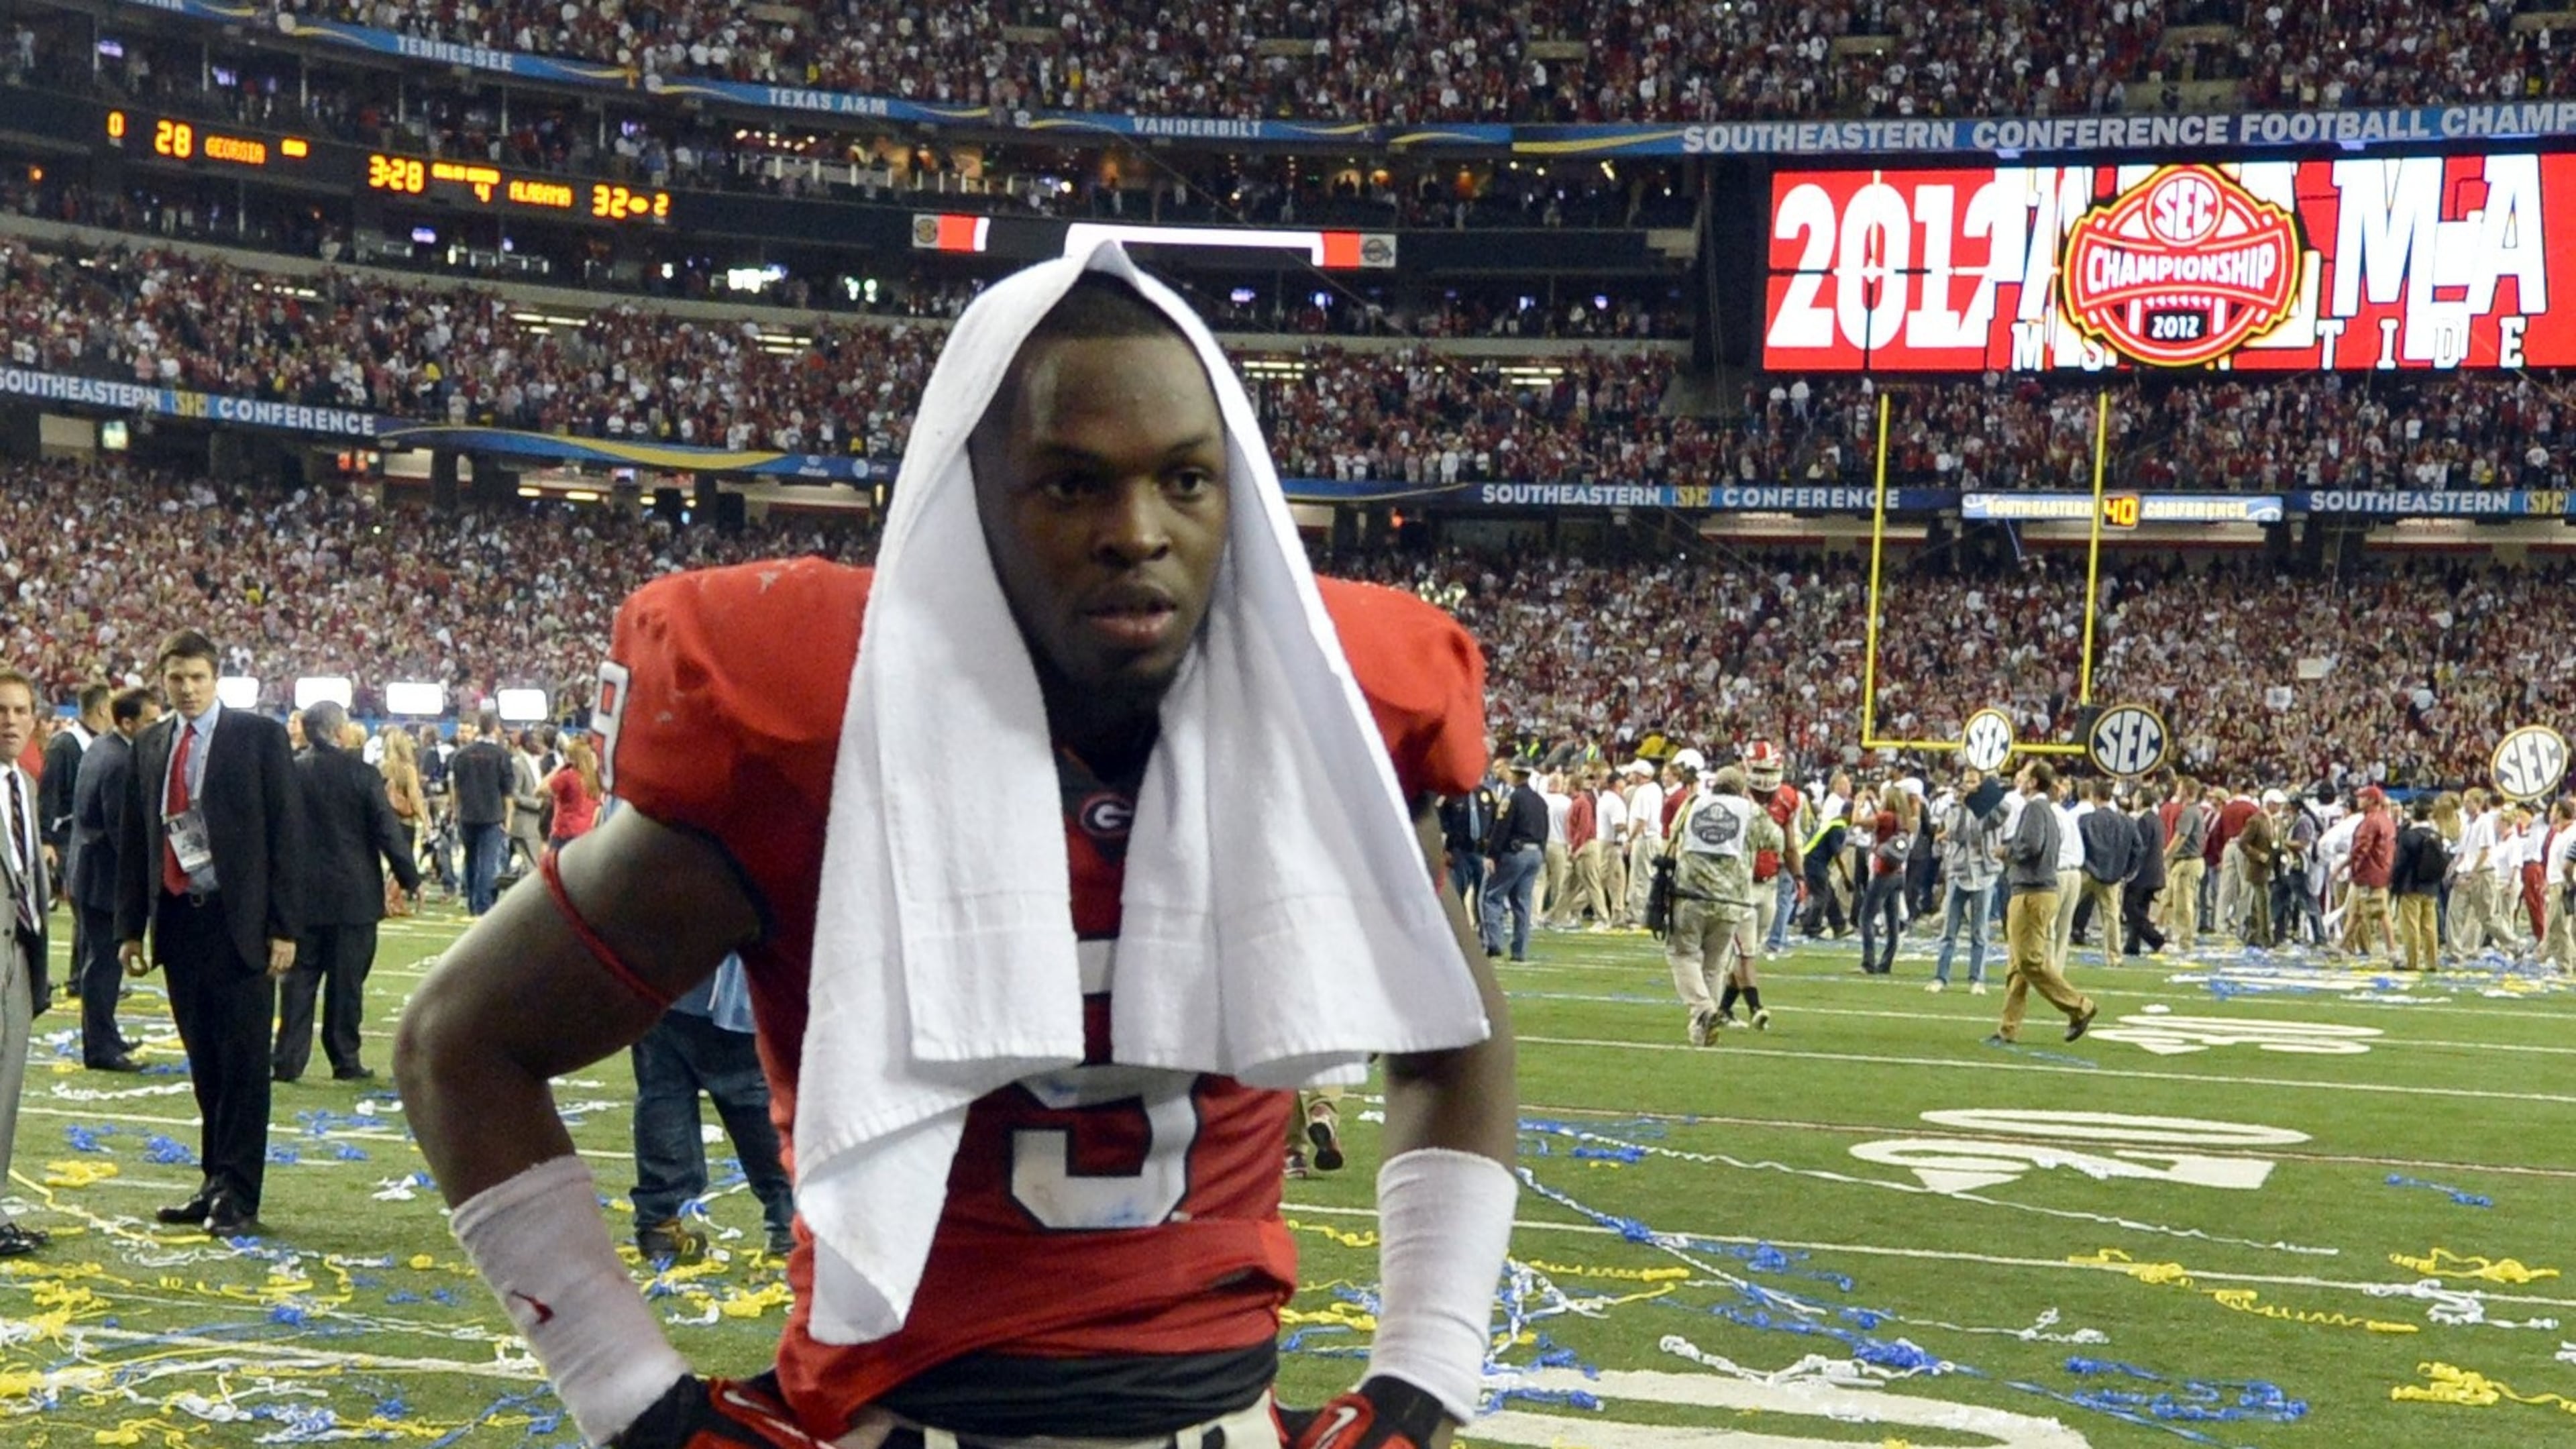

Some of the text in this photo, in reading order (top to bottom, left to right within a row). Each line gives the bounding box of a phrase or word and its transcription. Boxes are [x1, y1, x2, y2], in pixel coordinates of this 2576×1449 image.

[396, 34, 513, 71] TENNESSEE
[769, 87, 888, 117] TEXAS A&M
[154, 119, 193, 158] 28
[1132, 117, 1262, 137] VANDERBILT
[1682, 121, 1955, 152] SOUTHEASTERN
[1972, 115, 2230, 148] CONFERENCE
[2239, 109, 2430, 143] FOOTBALL
[368, 154, 424, 193] 3:28
[592, 184, 629, 219] 32
[2152, 178, 2216, 240] SEC
[2086, 242, 2276, 294] CHAMPIONSHIP
[2151, 314, 2200, 339] 2012
[218, 396, 375, 435] CONFERENCE
[1482, 484, 1661, 505] SOUTHEASTERN
[2104, 496, 2137, 527] 40
[2310, 490, 2510, 513] SOUTHEASTERN
[1965, 713, 2008, 771] SEC
[2095, 709, 2161, 773] SEC
[2496, 731, 2561, 795] SEC
